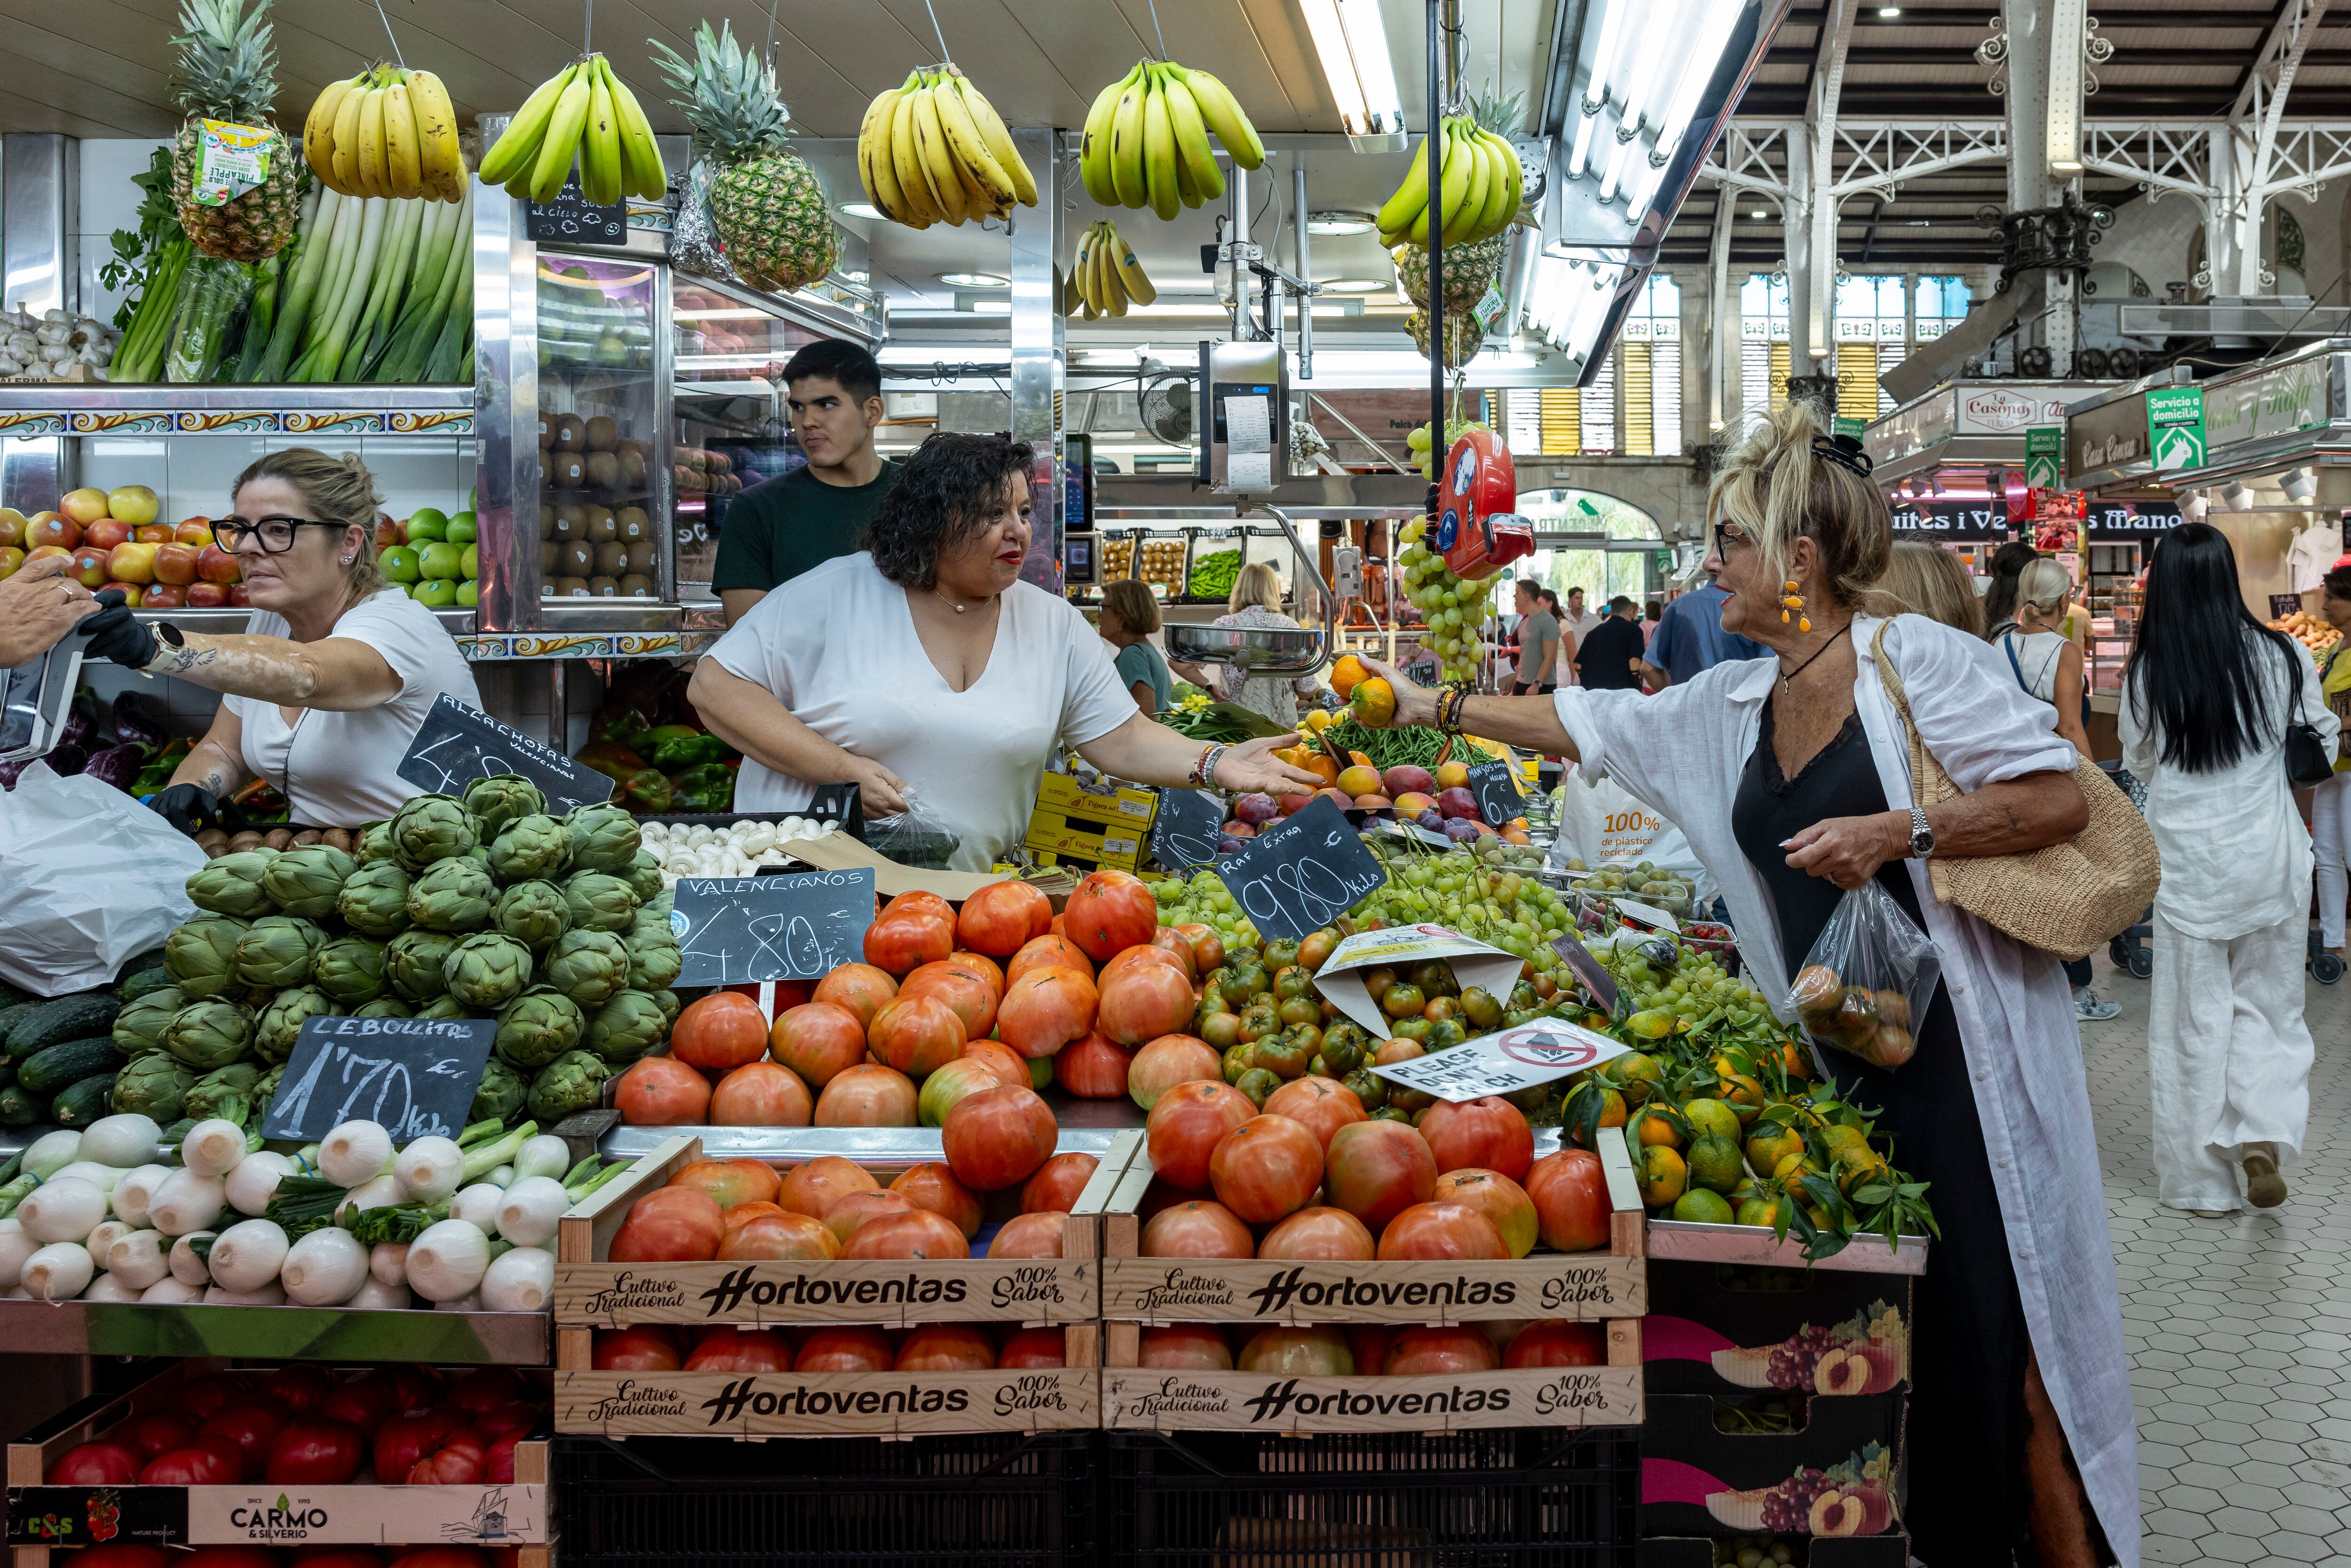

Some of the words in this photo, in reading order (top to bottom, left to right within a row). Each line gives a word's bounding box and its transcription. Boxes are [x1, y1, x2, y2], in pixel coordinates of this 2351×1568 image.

[210, 167, 254, 181] PINEAPPLE
[1970, 401, 2030, 419] Casona
[2150, 396, 2191, 409] Servicio
[1986, 419, 2014, 428] TERESA
[2153, 408, 2199, 421] domicilio
[443, 695, 572, 768] ALCACHOFAS
[1088, 800, 1107, 810] Figues
[1483, 783, 1502, 825] 6
[1203, 816, 1219, 841] Kilo
[1603, 812, 1660, 833] 100%
[1075, 841, 1095, 851] Figues
[1262, 826, 1302, 849] EXTRA
[1616, 836, 1653, 847] plástico
[1600, 847, 1643, 856] reciclado
[690, 871, 863, 893] VALENCIANOS
[1345, 873, 1379, 896] Kilo
[1384, 942, 1436, 953] GOURMET
[614, 1270, 678, 1294] Cultivo
[1013, 1267, 1058, 1283] 100%
[1165, 1268, 1227, 1292] Cultivo
[1563, 1268, 1607, 1284] 100%
[584, 1288, 686, 1315] Tradicional
[698, 1265, 968, 1317] Hortoventas
[991, 1276, 1065, 1308] Sabor
[1135, 1285, 1234, 1310] Tradicional
[1247, 1266, 1516, 1317] Hortoventas
[1540, 1278, 1615, 1310] Sabor
[616, 1379, 680, 1403] Cultivo
[1016, 1375, 1060, 1392] 100%
[1160, 1376, 1222, 1400] Cultivo
[1558, 1374, 1601, 1391] 100%
[588, 1396, 687, 1422] Tradicional
[700, 1376, 970, 1427] Hortoventas
[993, 1384, 1068, 1417] Sabor
[1131, 1393, 1230, 1418] Tradicional
[1243, 1378, 1511, 1424] Hortoventas
[1535, 1383, 1609, 1415] Sabor
[28, 1516, 73, 1536] C&S
[230, 1508, 328, 1528] CARMO
[249, 1529, 257, 1538] &
[259, 1529, 308, 1538] SILVÉRIO
